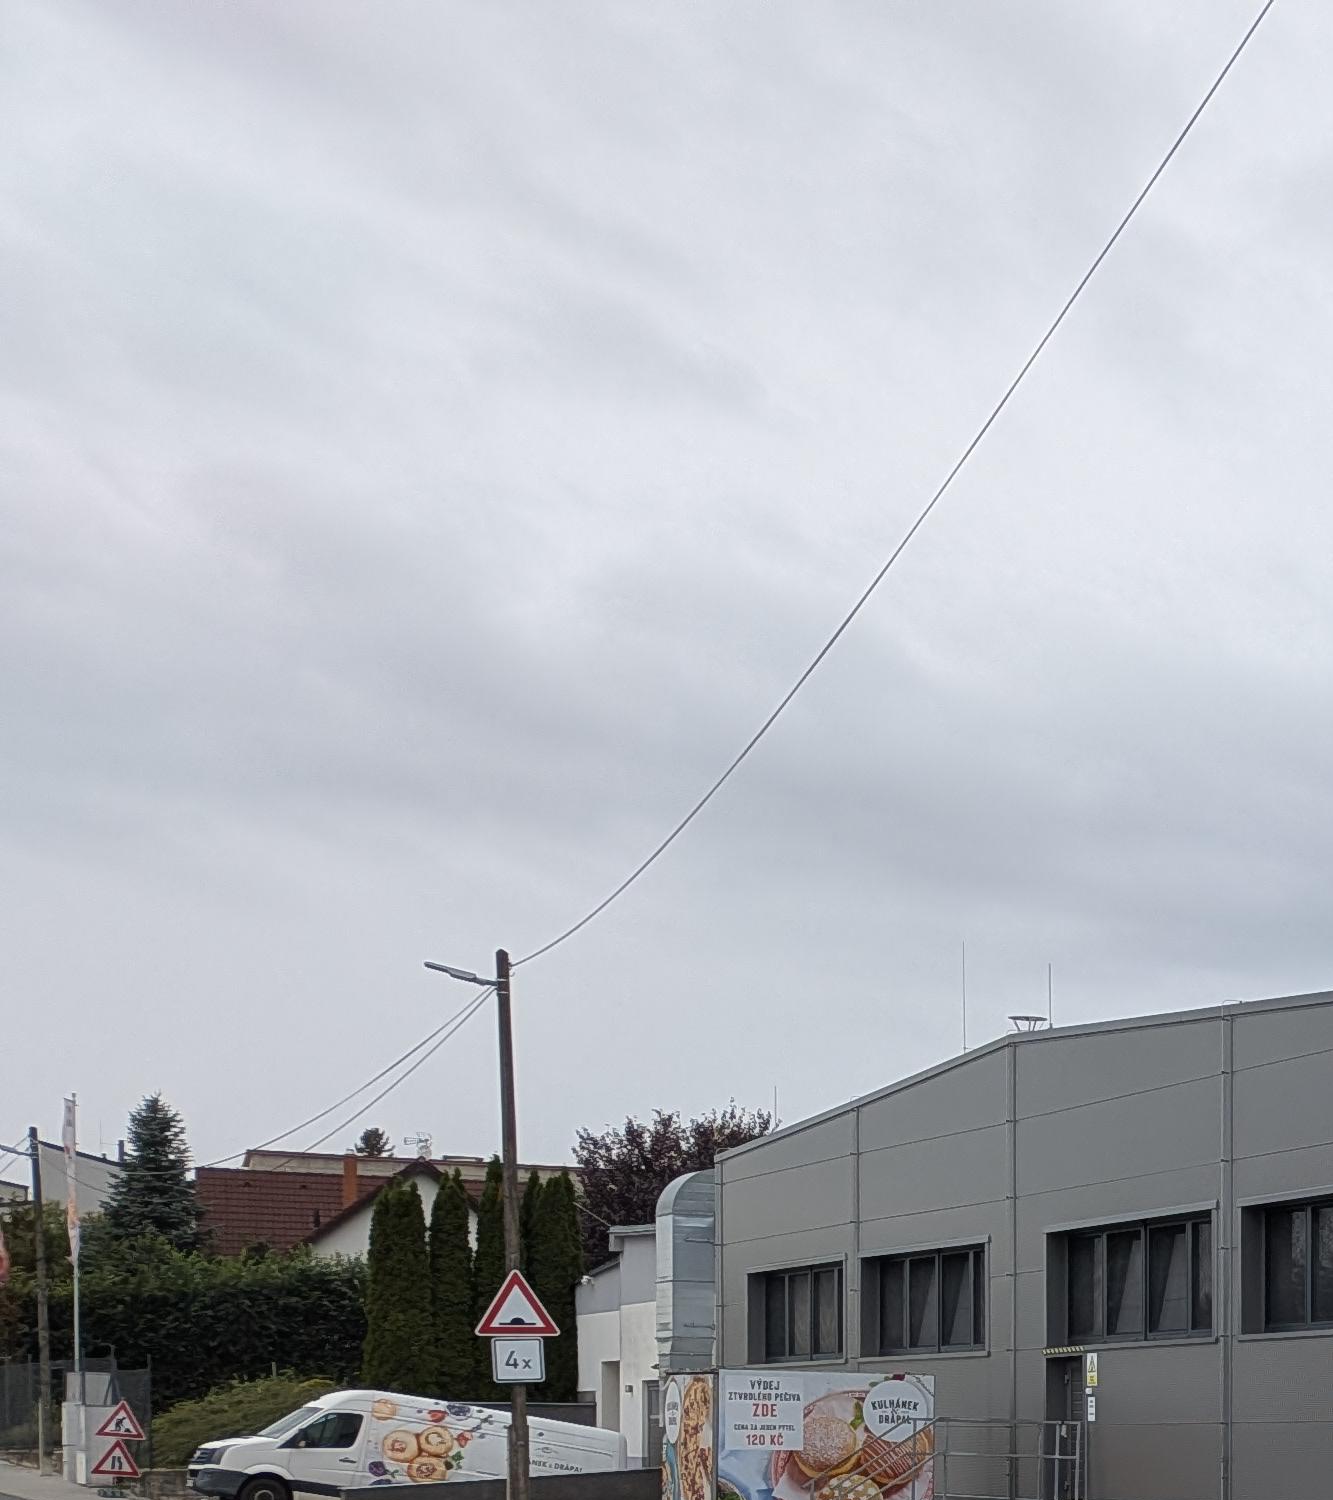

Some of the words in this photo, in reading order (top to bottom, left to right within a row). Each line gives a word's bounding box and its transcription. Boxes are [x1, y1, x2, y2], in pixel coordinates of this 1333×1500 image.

[505, 1350, 532, 1370] 4x
[749, 1378, 781, 1391] VÝDEJ
[774, 1392, 801, 1402] PEČIVA
[871, 1397, 919, 1411] KULHÁNEK
[752, 1403, 778, 1418] ZDE
[878, 1413, 912, 1425] DRÁPAL
[745, 1434, 766, 1446] 120
[769, 1432, 784, 1446] KČ
